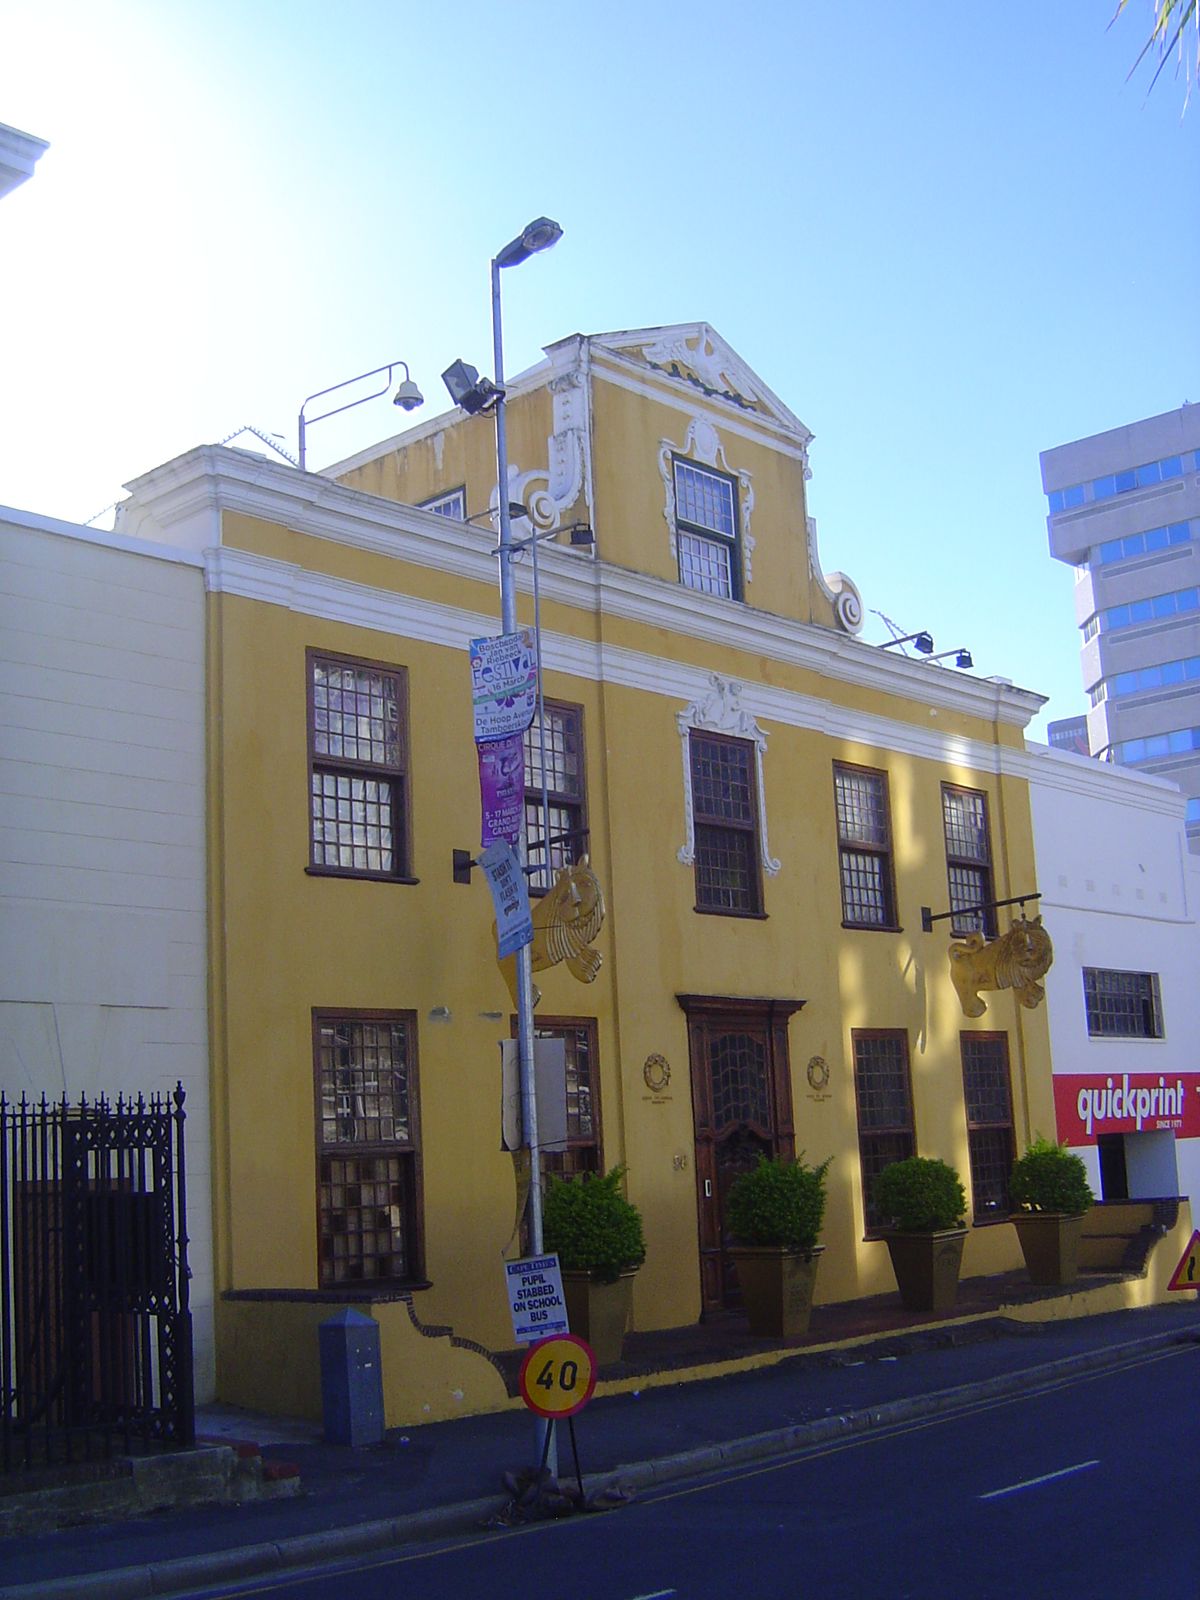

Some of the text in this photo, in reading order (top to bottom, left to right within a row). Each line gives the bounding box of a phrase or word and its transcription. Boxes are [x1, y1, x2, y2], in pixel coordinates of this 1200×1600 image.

[492, 675, 526, 692] 16 March
[490, 715, 512, 725] Hoop
[1077, 1073, 1184, 1135] quickprint
[521, 1273, 547, 1287] PUPIL
[516, 1284, 555, 1300] STABBED
[513, 1295, 563, 1313] ON SCHOOL
[530, 1310, 549, 1322] BUS
[536, 1359, 579, 1392] 40
